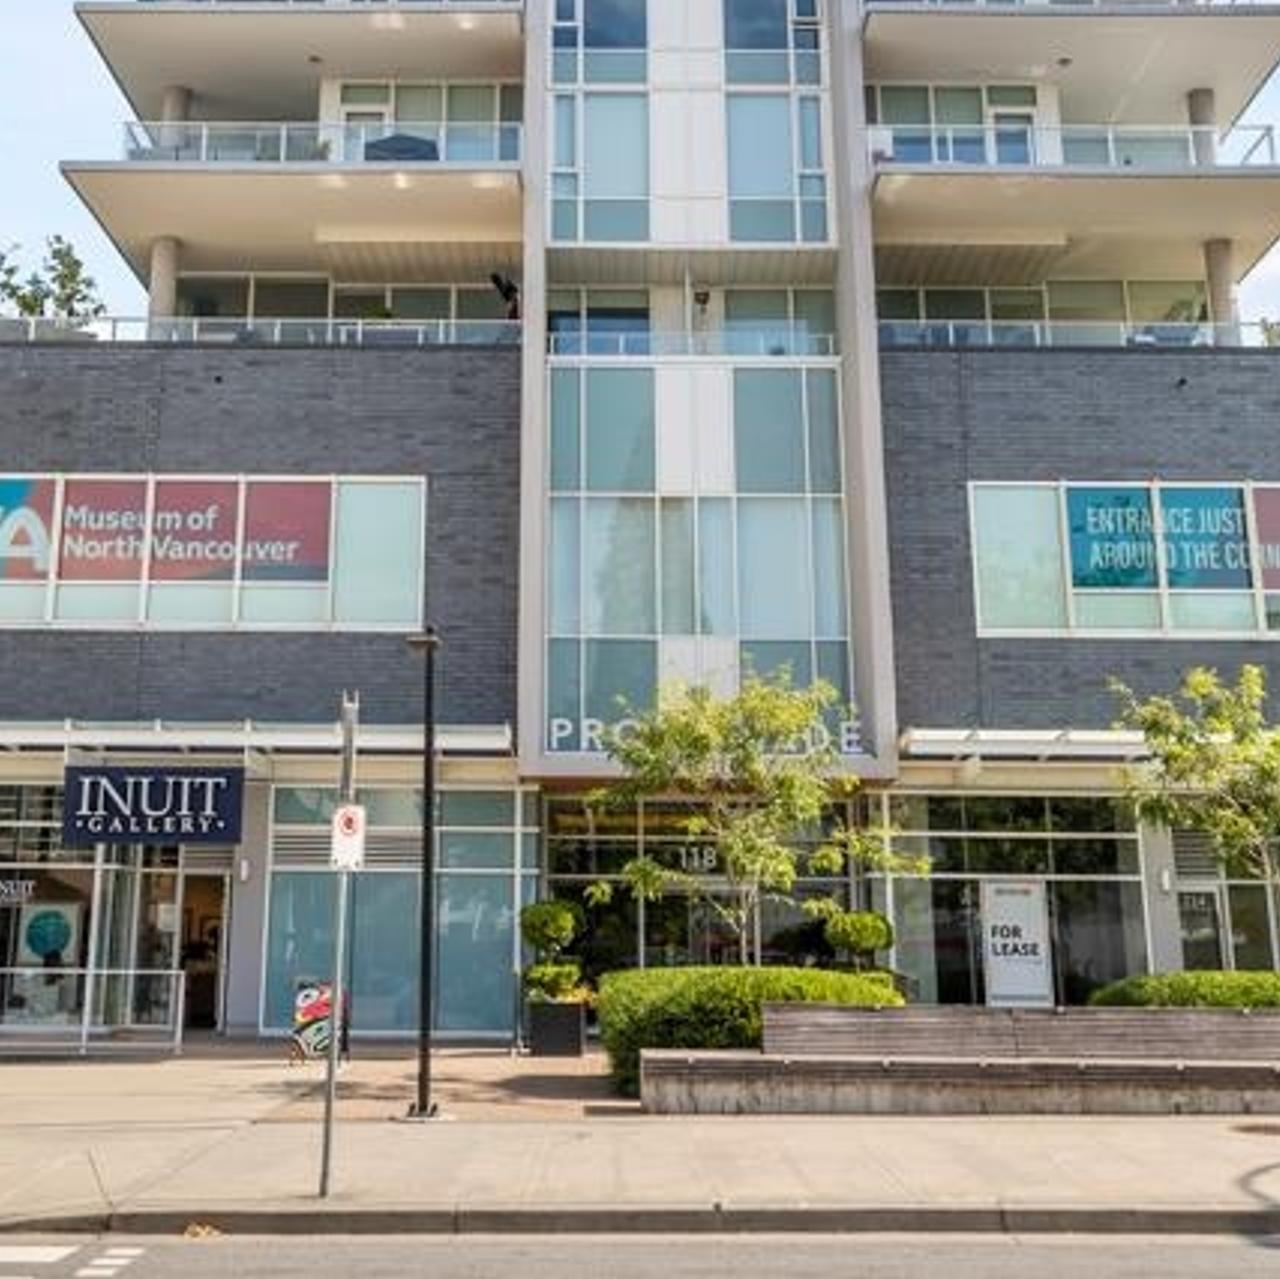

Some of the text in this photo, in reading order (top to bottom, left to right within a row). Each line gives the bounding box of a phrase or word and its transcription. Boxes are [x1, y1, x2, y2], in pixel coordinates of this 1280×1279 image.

[64, 505, 219, 531] Museum of
[1198, 506, 1244, 534] JUST
[63, 534, 300, 561] North Vancouver
[1180, 541, 1220, 569] THE
[76, 775, 227, 816] INUIT
[86, 816, 213, 834] GALLERY
[679, 846, 717, 869] 118
[991, 924, 1022, 939] FOR
[991, 942, 1040, 957] LEASE
